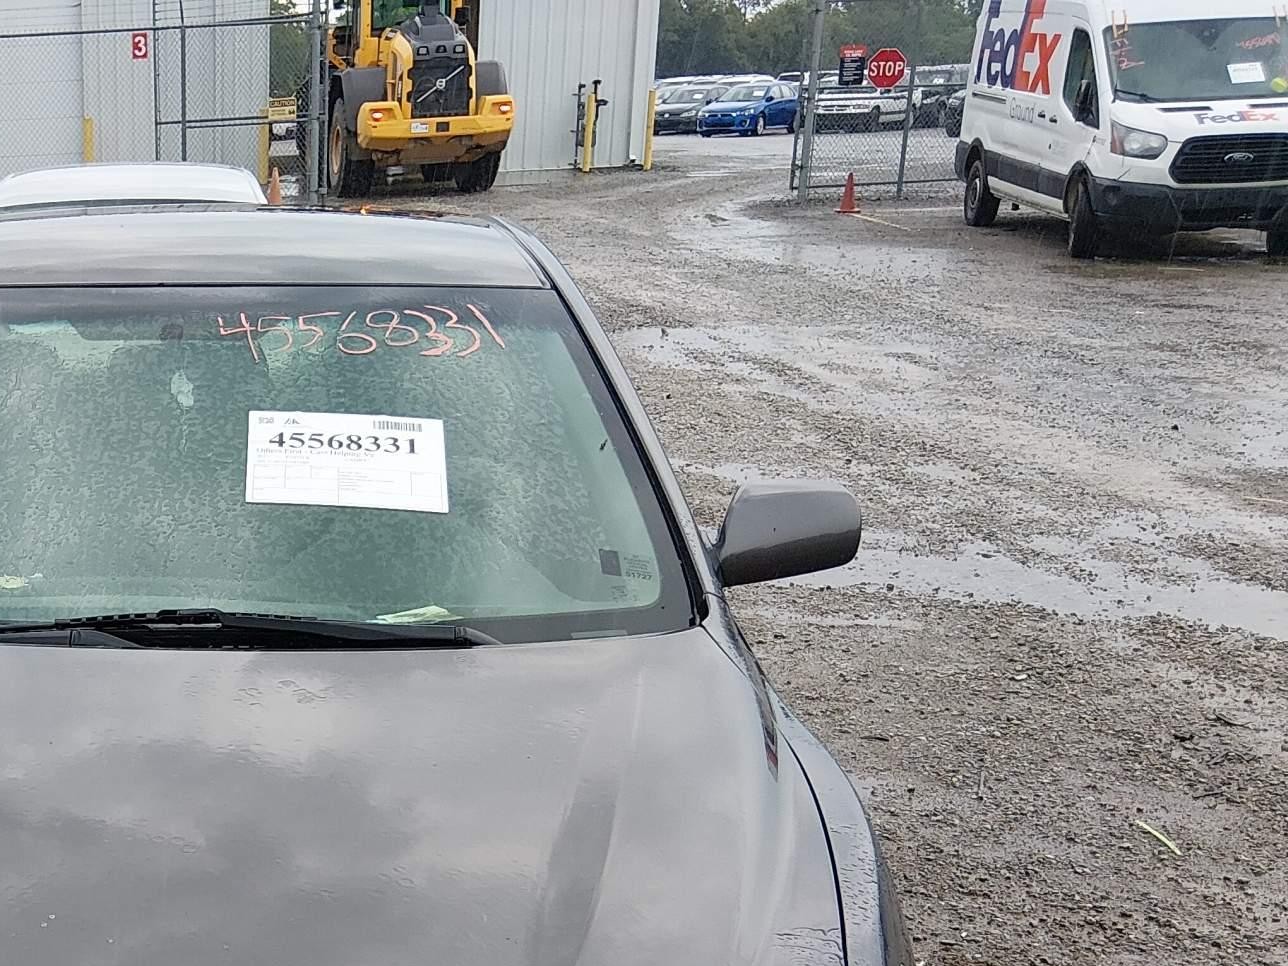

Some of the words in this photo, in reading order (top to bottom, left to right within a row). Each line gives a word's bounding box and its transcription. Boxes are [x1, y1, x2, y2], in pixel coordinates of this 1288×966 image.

[133, 35, 146, 56] 3
[974, 0, 1063, 96] FedEx
[869, 61, 904, 77] STOP
[1009, 97, 1035, 124] Ground
[1193, 110, 1280, 125] FedEx
[216, 304, 506, 364] 45568331
[268, 431, 420, 455] 45568331
